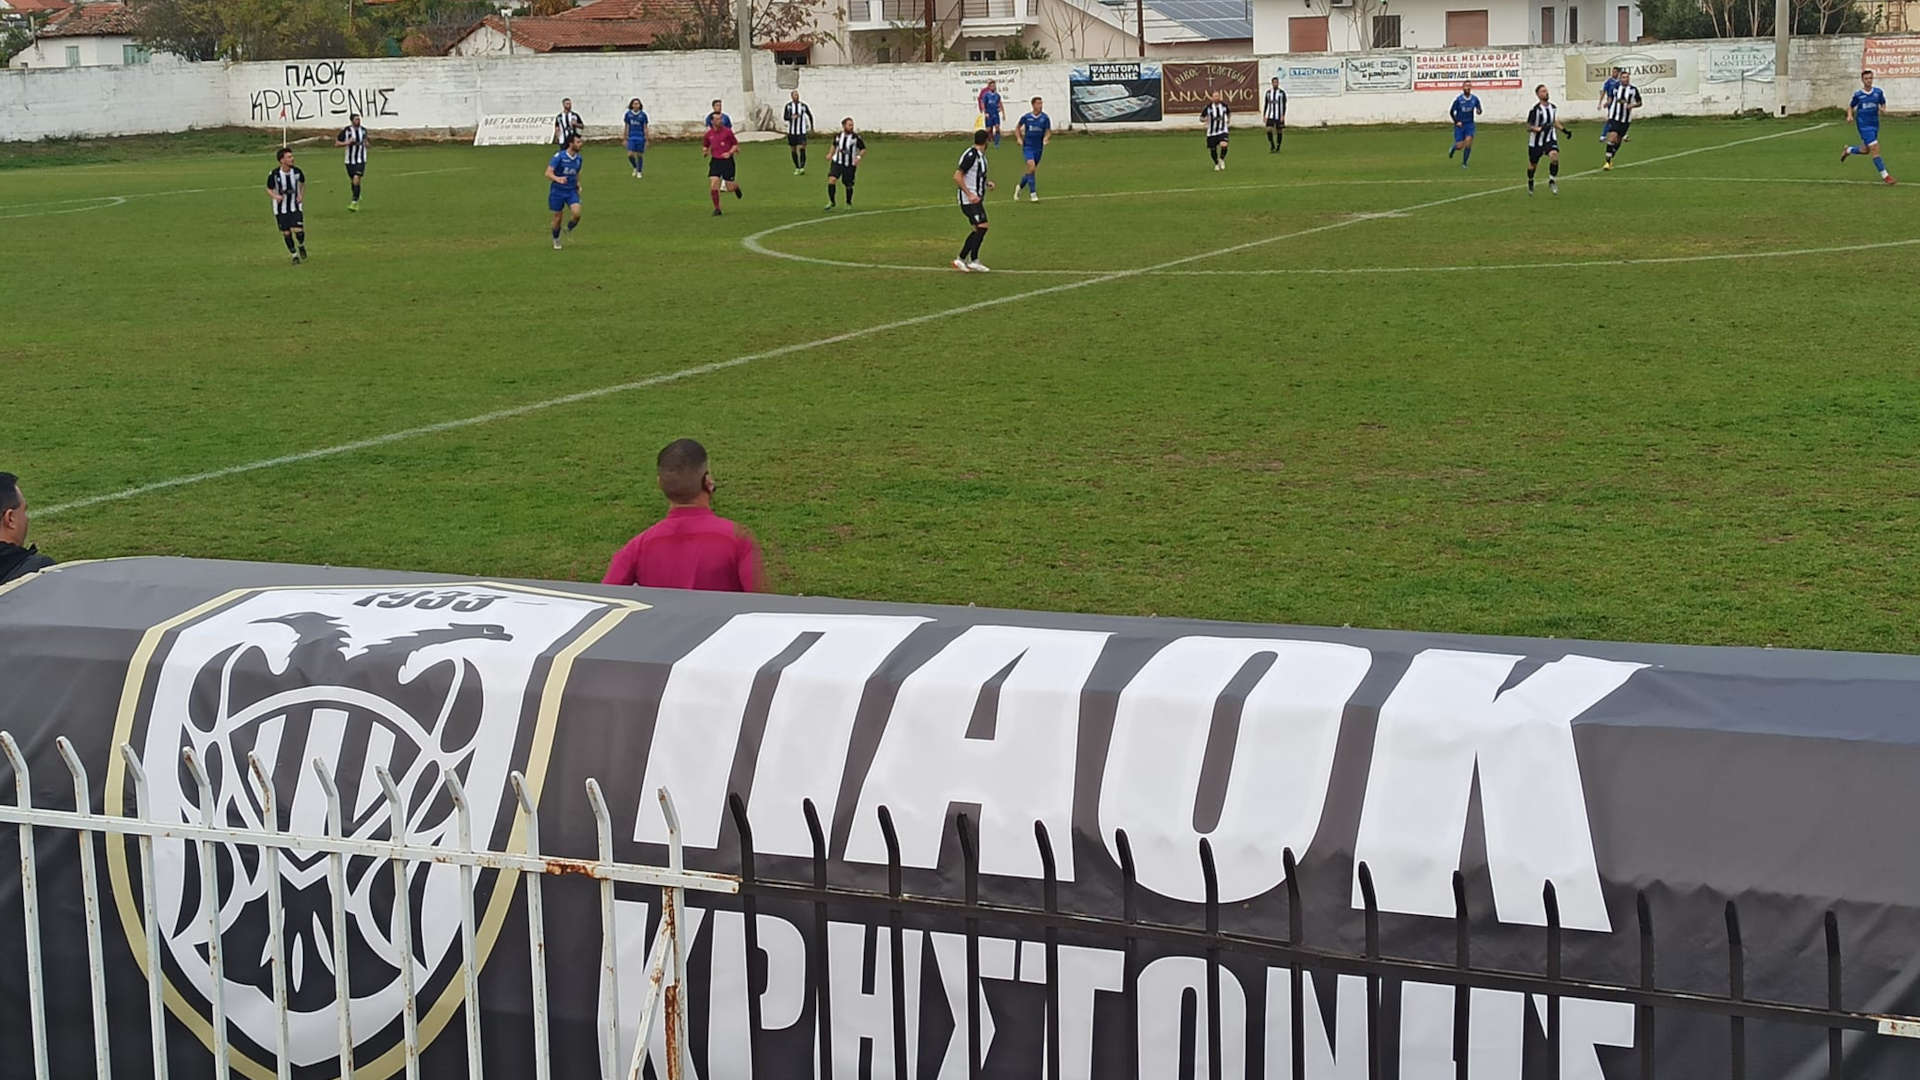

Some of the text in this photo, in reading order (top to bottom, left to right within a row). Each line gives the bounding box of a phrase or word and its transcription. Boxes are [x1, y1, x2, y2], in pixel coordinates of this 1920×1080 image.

[1090, 64, 1139, 73] ΨΑΡΑΓΟΡΑ
[1462, 53, 1520, 62] ΜΕΤΑΦΟΡΕΣ
[285, 61, 345, 87] ΠΑΟΚ
[250, 88, 399, 122] ΚΡΗΣΤΩΝΗΣ
[352, 590, 508, 612] 1933
[633, 613, 1653, 933] ΠΑΟΚ
